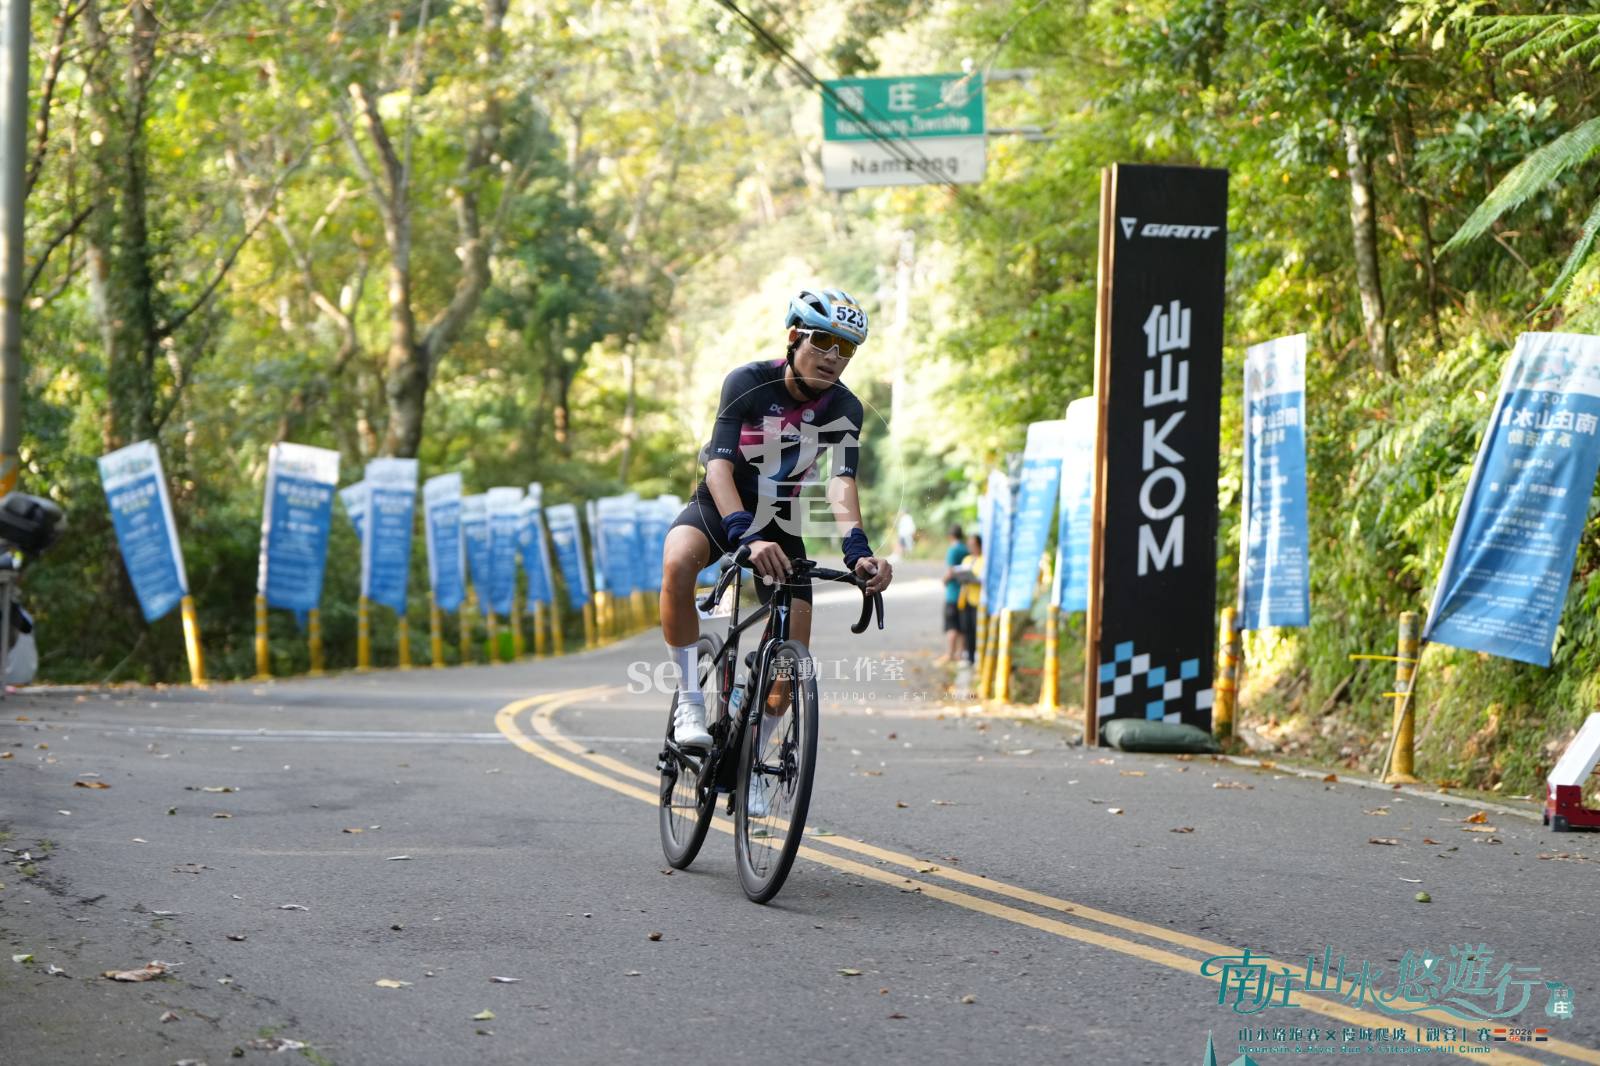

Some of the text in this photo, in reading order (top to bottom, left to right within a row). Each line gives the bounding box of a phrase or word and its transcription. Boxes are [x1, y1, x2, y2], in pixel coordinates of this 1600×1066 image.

[1141, 223, 1220, 239] GIANT
[836, 306, 864, 328] 523
[1137, 300, 1192, 577] 仙山KOM
